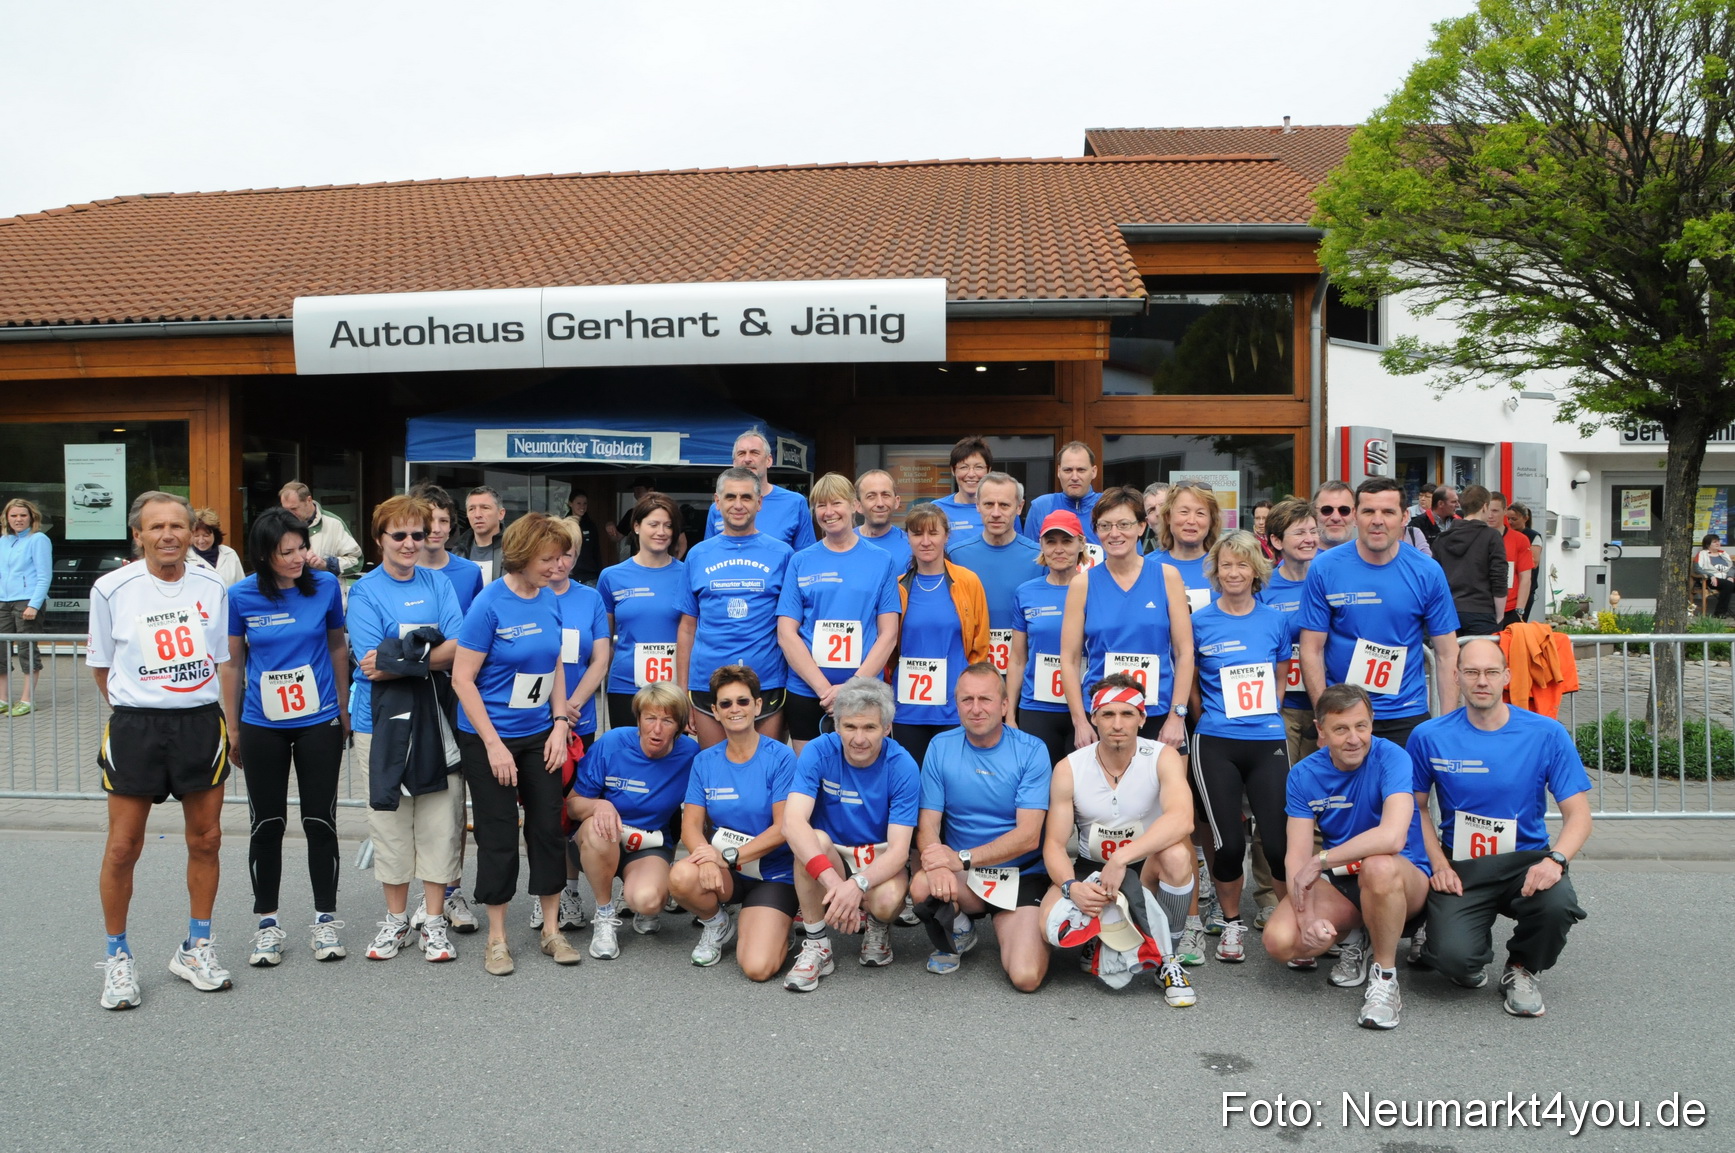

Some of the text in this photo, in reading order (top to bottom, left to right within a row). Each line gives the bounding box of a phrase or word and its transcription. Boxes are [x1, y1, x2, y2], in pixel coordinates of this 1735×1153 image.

[329, 304, 906, 349] Autohaus Gerhart & Jänig
[513, 437, 645, 457] Neumarkter Tagblatt
[704, 558, 770, 575] funrunners
[146, 612, 176, 624] MEYER
[154, 626, 194, 661] 86
[828, 634, 852, 662] 21
[1364, 644, 1391, 655] MEYER
[646, 657, 673, 683] 65
[1229, 667, 1254, 676] MEYER
[1287, 659, 1301, 686] 5
[1364, 658, 1392, 688] 16
[527, 676, 543, 703] 4
[908, 674, 933, 701] 72
[1052, 670, 1066, 697] 6
[1237, 680, 1264, 711] 67
[276, 684, 306, 713] 13
[1098, 827, 1123, 836] MEYER
[1465, 815, 1491, 826] MEYER
[626, 833, 643, 852] 9
[723, 831, 744, 842] MEYER
[1470, 832, 1498, 859] 61
[1101, 840, 1132, 861] 8
[982, 881, 997, 898] 7
